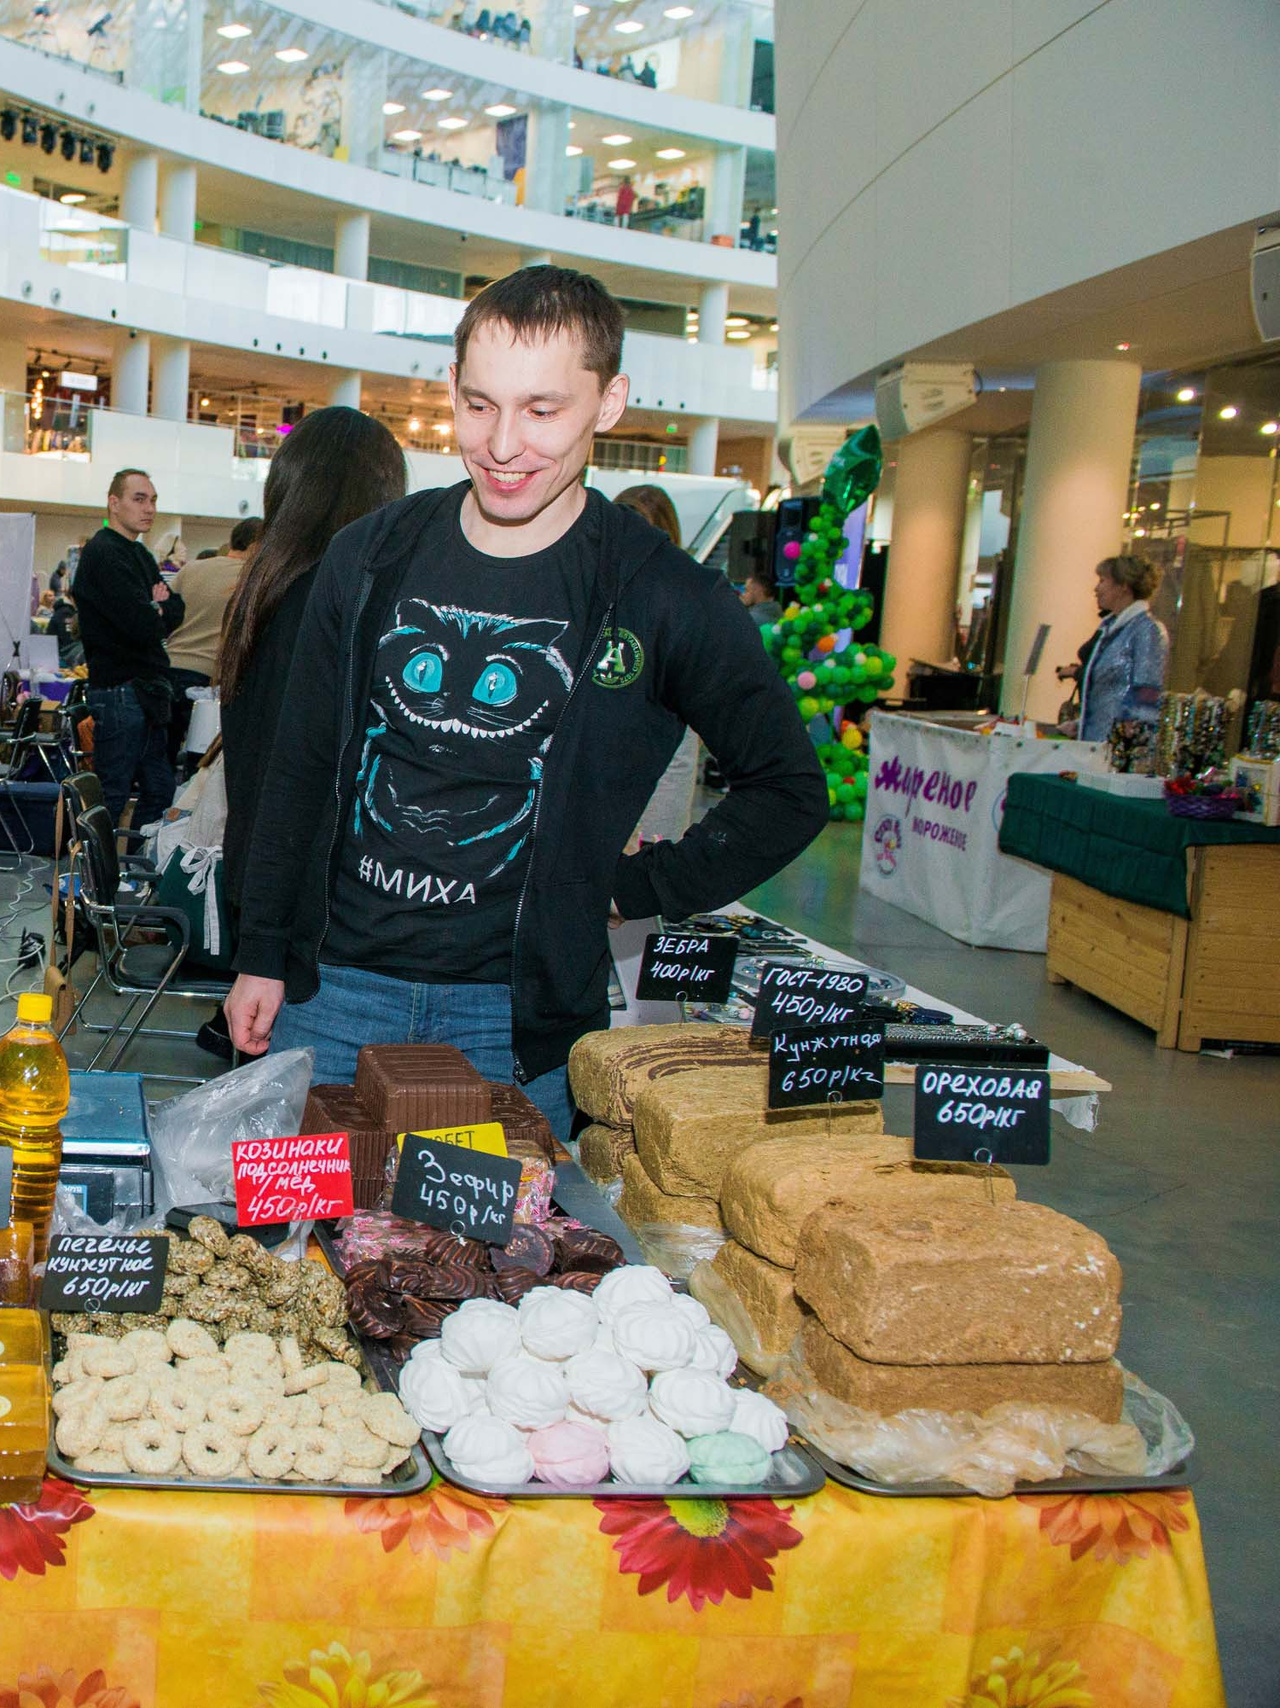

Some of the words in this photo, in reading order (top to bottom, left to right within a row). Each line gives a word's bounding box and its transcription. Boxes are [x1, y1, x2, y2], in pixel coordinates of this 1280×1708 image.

[358, 855, 475, 904] #МИХА
[653, 936, 709, 954] ЗЕБРА
[763, 968, 863, 993] ГОСТ-1980
[775, 1033, 881, 1062] Кунжутная
[923, 1072, 1042, 1099] ОРЕХОВАЯ
[236, 1138, 343, 1161] КОЗИНАКИ
[417, 1149, 514, 1207] Зефир
